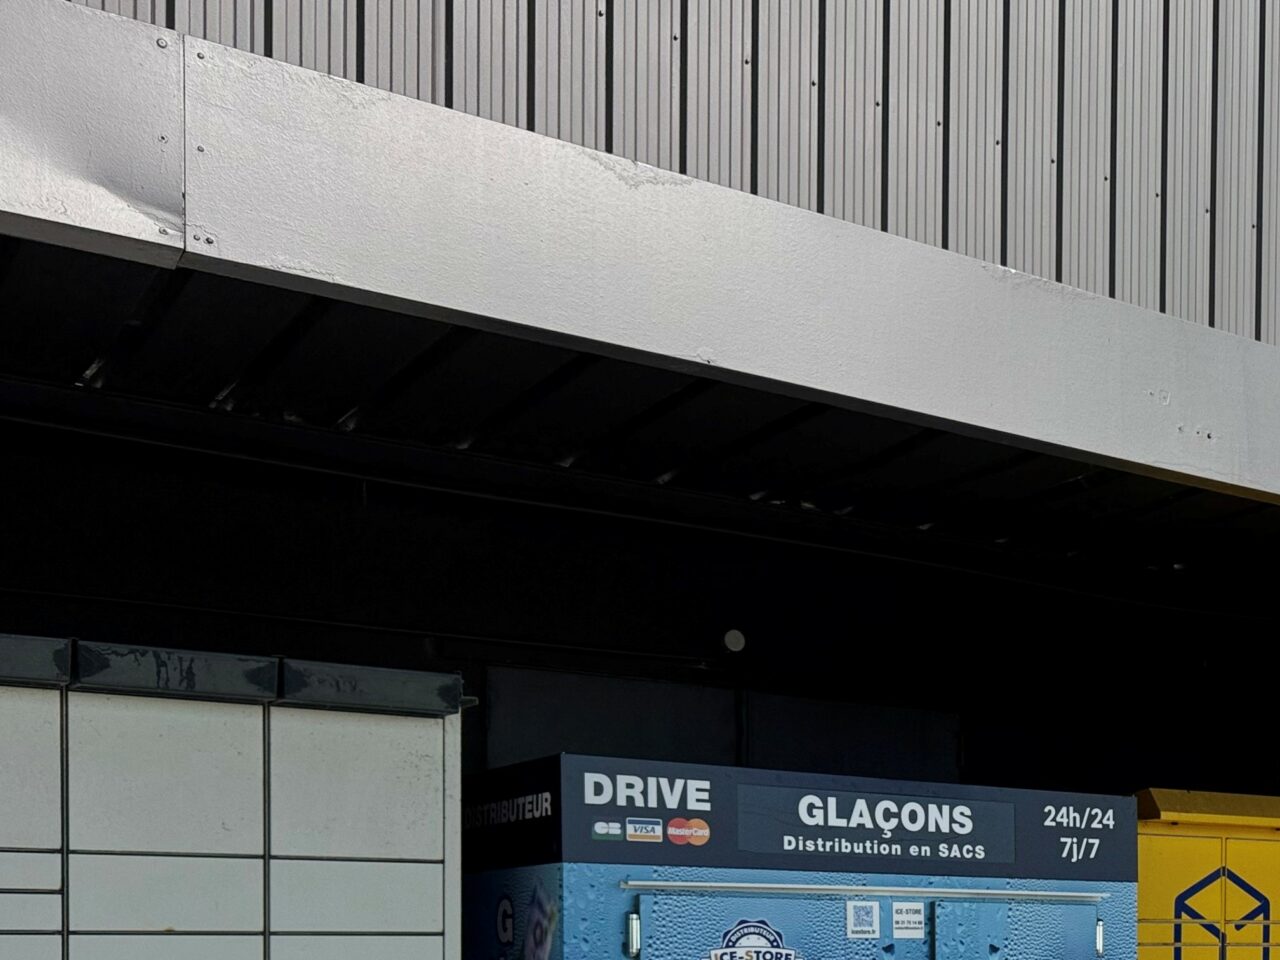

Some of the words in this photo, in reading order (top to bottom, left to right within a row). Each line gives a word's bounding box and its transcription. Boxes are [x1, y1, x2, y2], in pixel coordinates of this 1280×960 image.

[584, 772, 711, 811] DRIVE
[798, 794, 973, 838] GLAÇONS
[1043, 806, 1115, 829] 24h/24
[633, 825, 656, 836] VISA
[783, 835, 901, 855] Distribution
[910, 845, 931, 857] en
[938, 843, 986, 859] SACS
[1059, 837, 1100, 863] 7j/7
[730, 926, 775, 942] DISTRIBUTEUR
